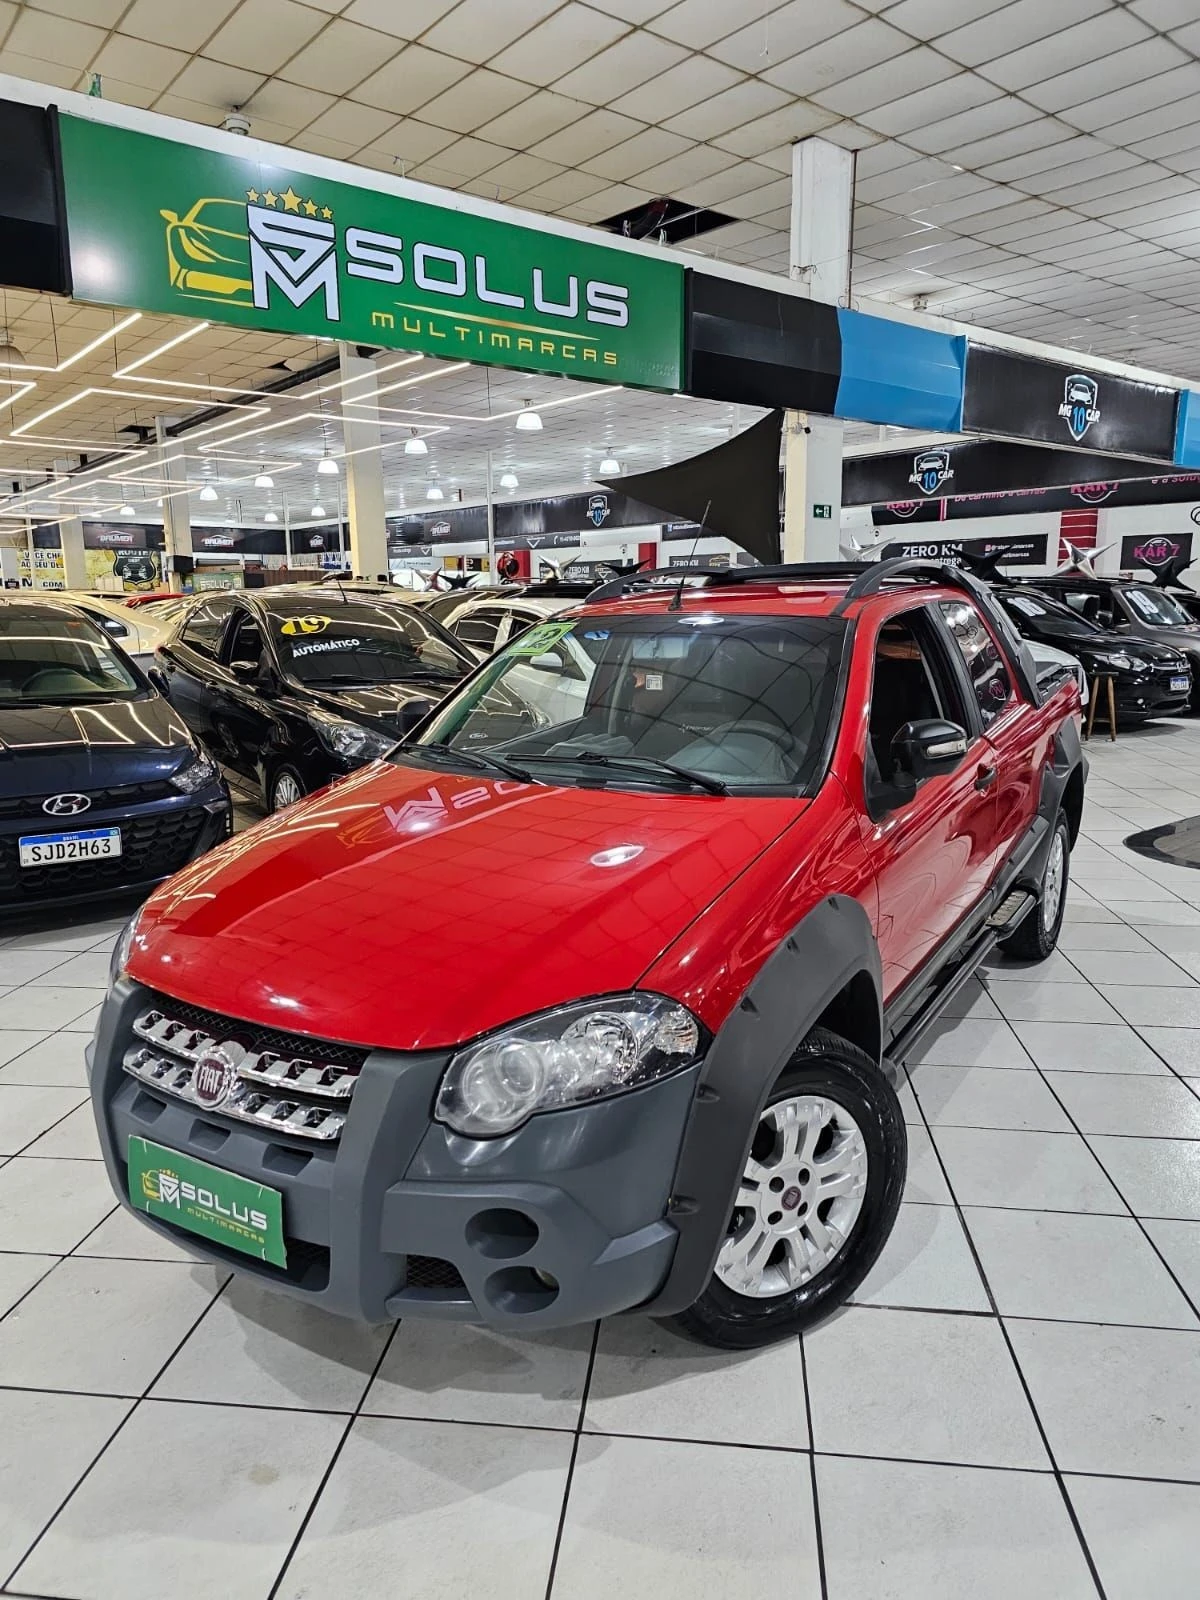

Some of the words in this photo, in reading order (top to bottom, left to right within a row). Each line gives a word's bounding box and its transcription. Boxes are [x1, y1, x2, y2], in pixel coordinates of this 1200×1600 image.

[345, 226, 629, 328] SOLUS
[371, 311, 618, 366] MULTIMARCAS
[1058, 403, 1072, 418] MG
[1073, 406, 1085, 432] 10
[1086, 408, 1101, 423] CAR
[908, 473, 922, 483] MG
[923, 472, 937, 489] 10
[938, 469, 954, 480] CAR
[902, 545, 938, 558] ZERO
[1134, 546, 1167, 559] KAR
[1171, 544, 1181, 556] 7
[290, 616, 328, 635] 19
[292, 638, 360, 658] AUTOMÁTICO
[31, 838, 111, 862] SJD2H63
[198, 1066, 222, 1094] FIAT
[181, 1183, 268, 1231] SOLUS
[187, 1207, 265, 1244] MULTIMARCAS
